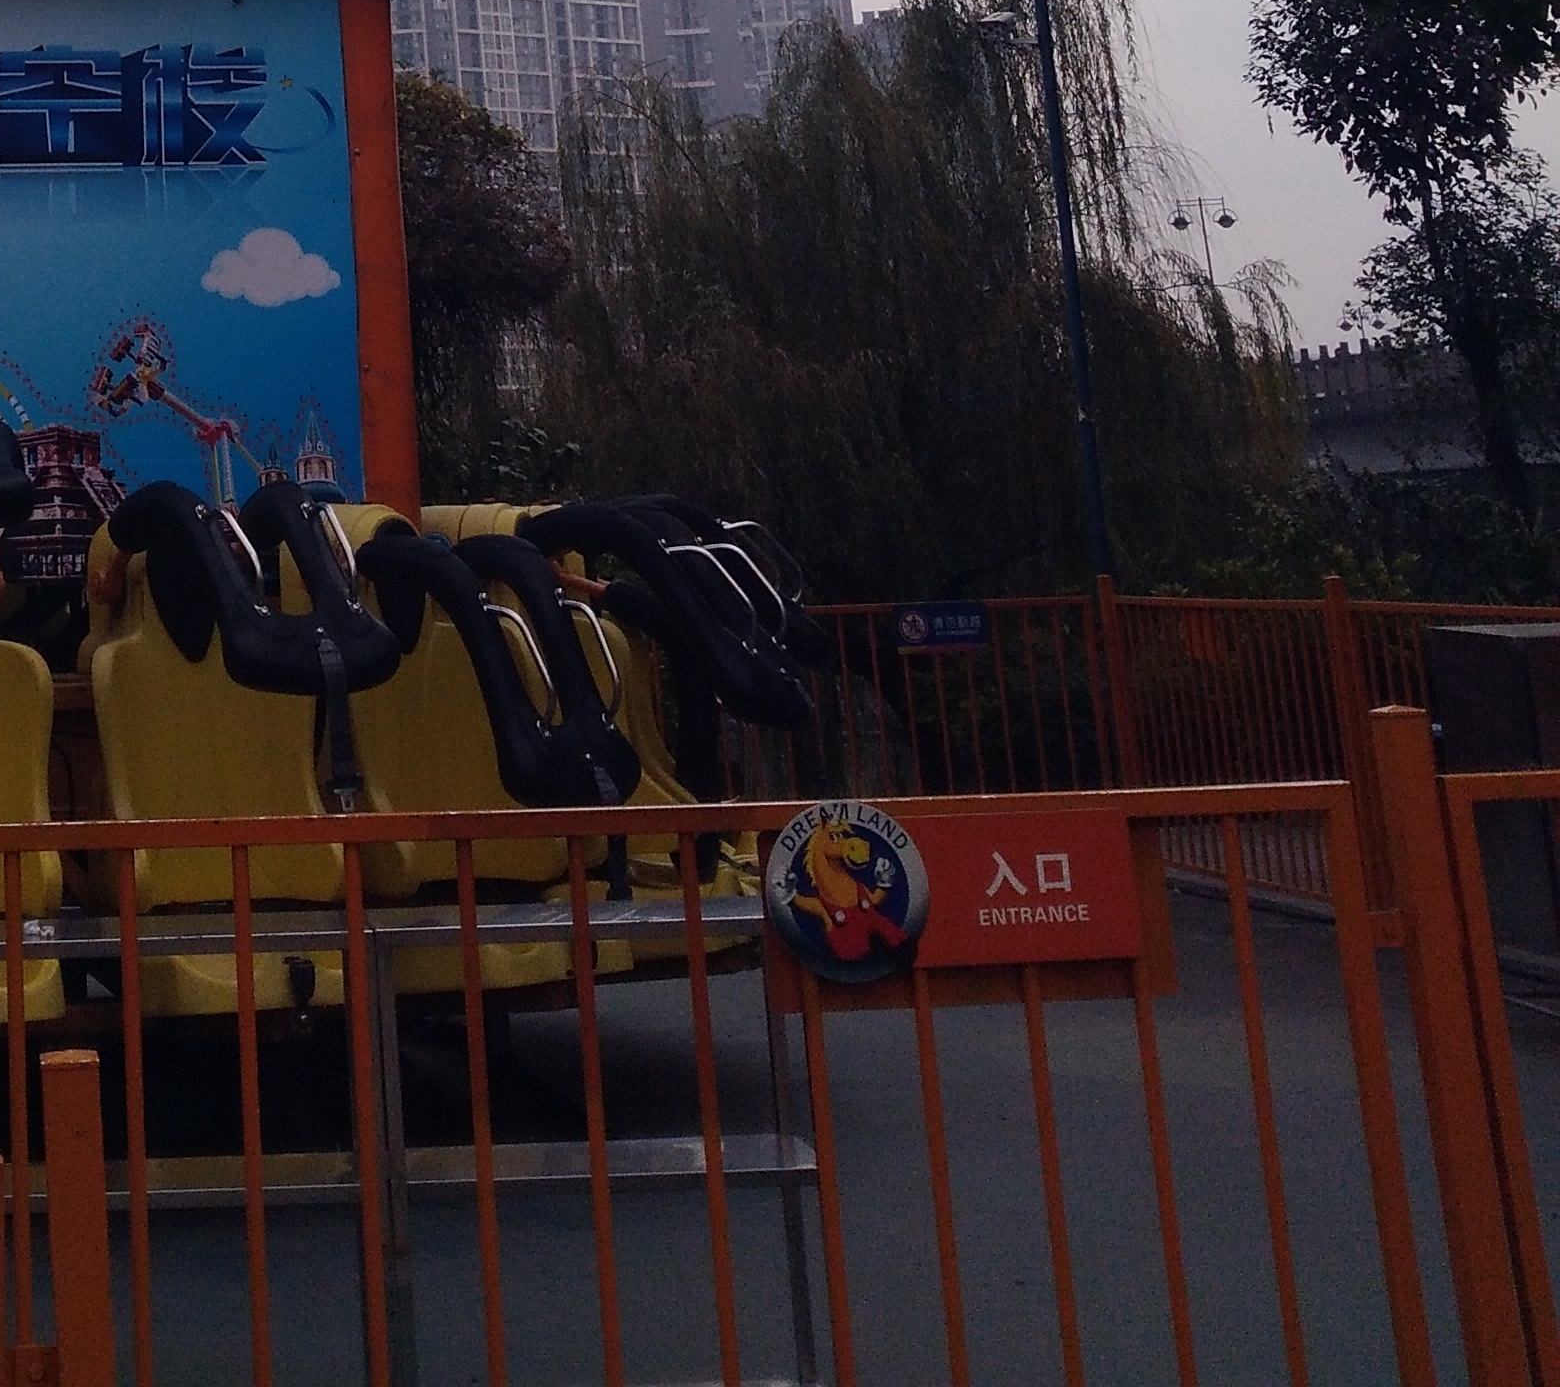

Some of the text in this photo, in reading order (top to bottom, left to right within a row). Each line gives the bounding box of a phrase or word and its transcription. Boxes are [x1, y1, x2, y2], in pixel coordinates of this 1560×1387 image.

[856, 804, 909, 849] LAND
[985, 850, 1072, 897] 入口
[978, 903, 1091, 927] ENTRANCE
